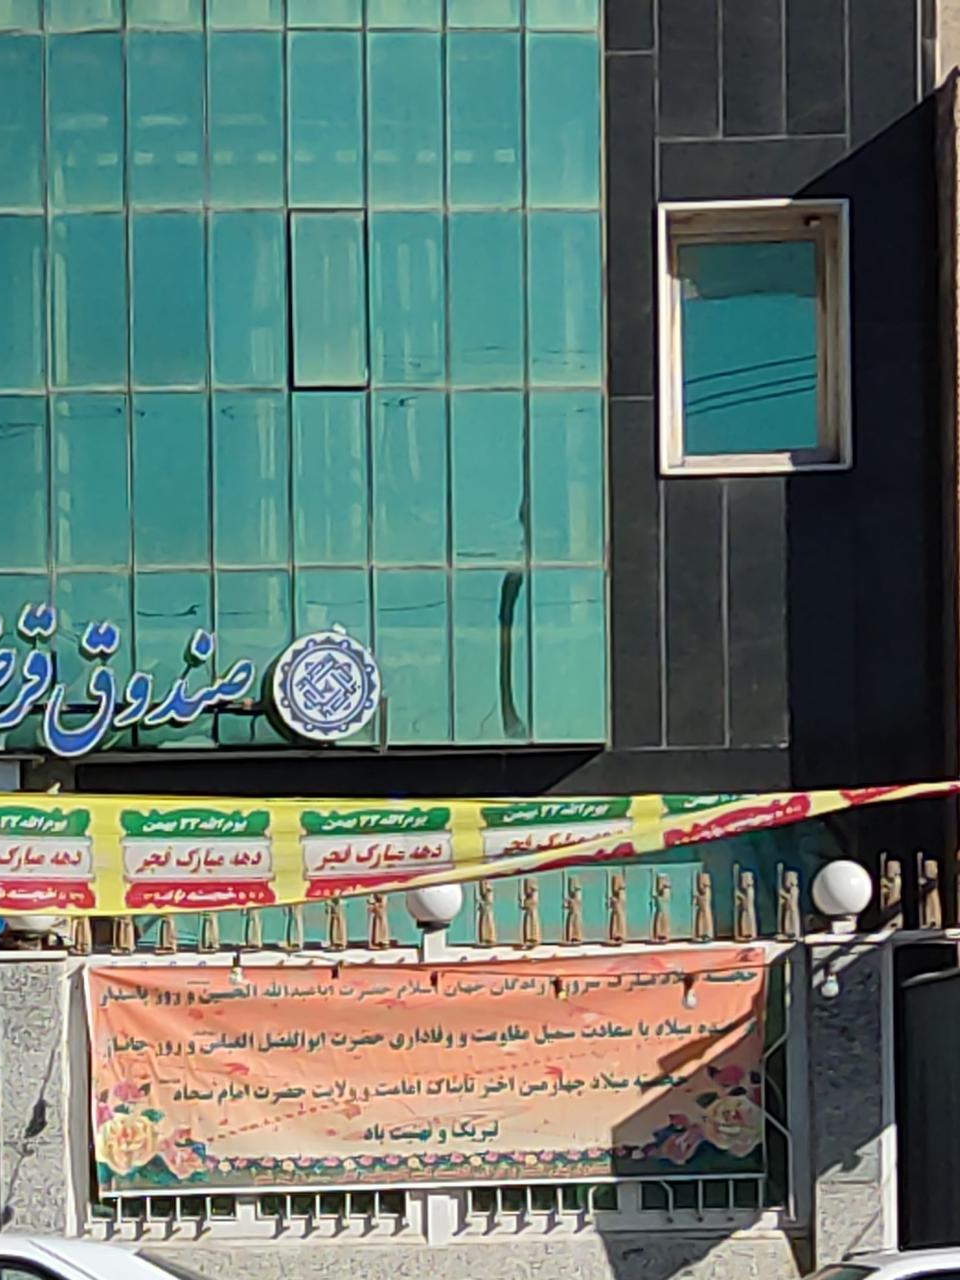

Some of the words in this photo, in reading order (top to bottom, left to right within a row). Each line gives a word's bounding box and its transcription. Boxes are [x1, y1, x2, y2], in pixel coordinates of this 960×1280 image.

[44, 620, 254, 758] صندوق
[142, 819, 178, 832] بهمن
[50, 850, 82, 865] دهه
[135, 845, 172, 874] فجر
[175, 847, 225, 874] مبارک
[229, 851, 262, 866] دهه
[315, 843, 352, 871] فجر
[356, 843, 405, 869] مبارک
[409, 843, 442, 859] دهه
[155, 988, 181, 1005] روز
[187, 991, 195, 1005] و
[340, 985, 391, 1001] حضرت
[459, 1031, 468, 1048] و
[581, 1021, 633, 1039] سعادت
[638, 1019, 649, 1041] با
[655, 1017, 692, 1041] میلاد
[187, 1039, 196, 1056] و
[258, 1029, 326, 1053] ابوالفضل
[331, 1029, 384, 1052] حضرت
[173, 1083, 213, 1101] سجاد
[217, 1082, 251, 1106] امام
[253, 1081, 306, 1106] حضرت
[591, 1073, 629, 1094] میلاد
[363, 1122, 385, 1145] باد
[438, 1128, 447, 1145] و
